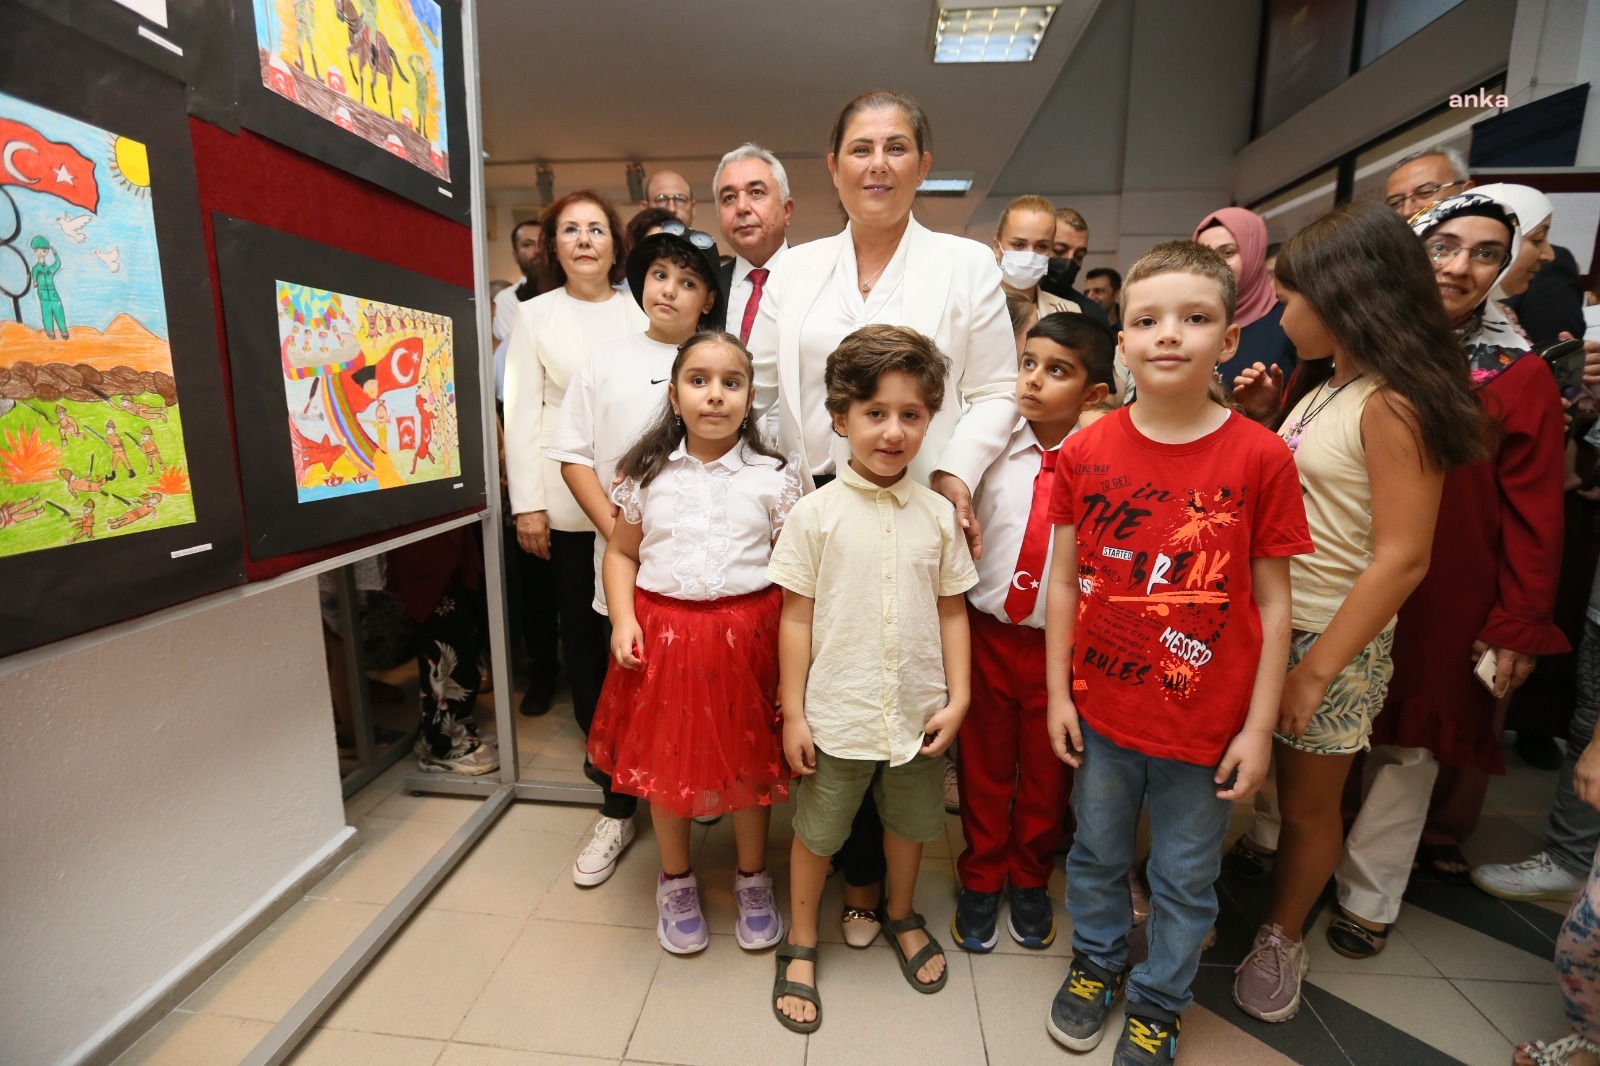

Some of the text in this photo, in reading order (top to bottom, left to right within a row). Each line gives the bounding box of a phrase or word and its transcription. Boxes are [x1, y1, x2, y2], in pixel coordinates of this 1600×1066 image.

[1077, 464, 1111, 473] THE WAY
[1101, 475, 1128, 491] TO GET
[1077, 493, 1152, 546] THE
[1103, 547, 1132, 560] STARTED
[1127, 549, 1231, 597] BREAK
[1083, 646, 1152, 686] RULES
[1159, 626, 1212, 666] MESSED
